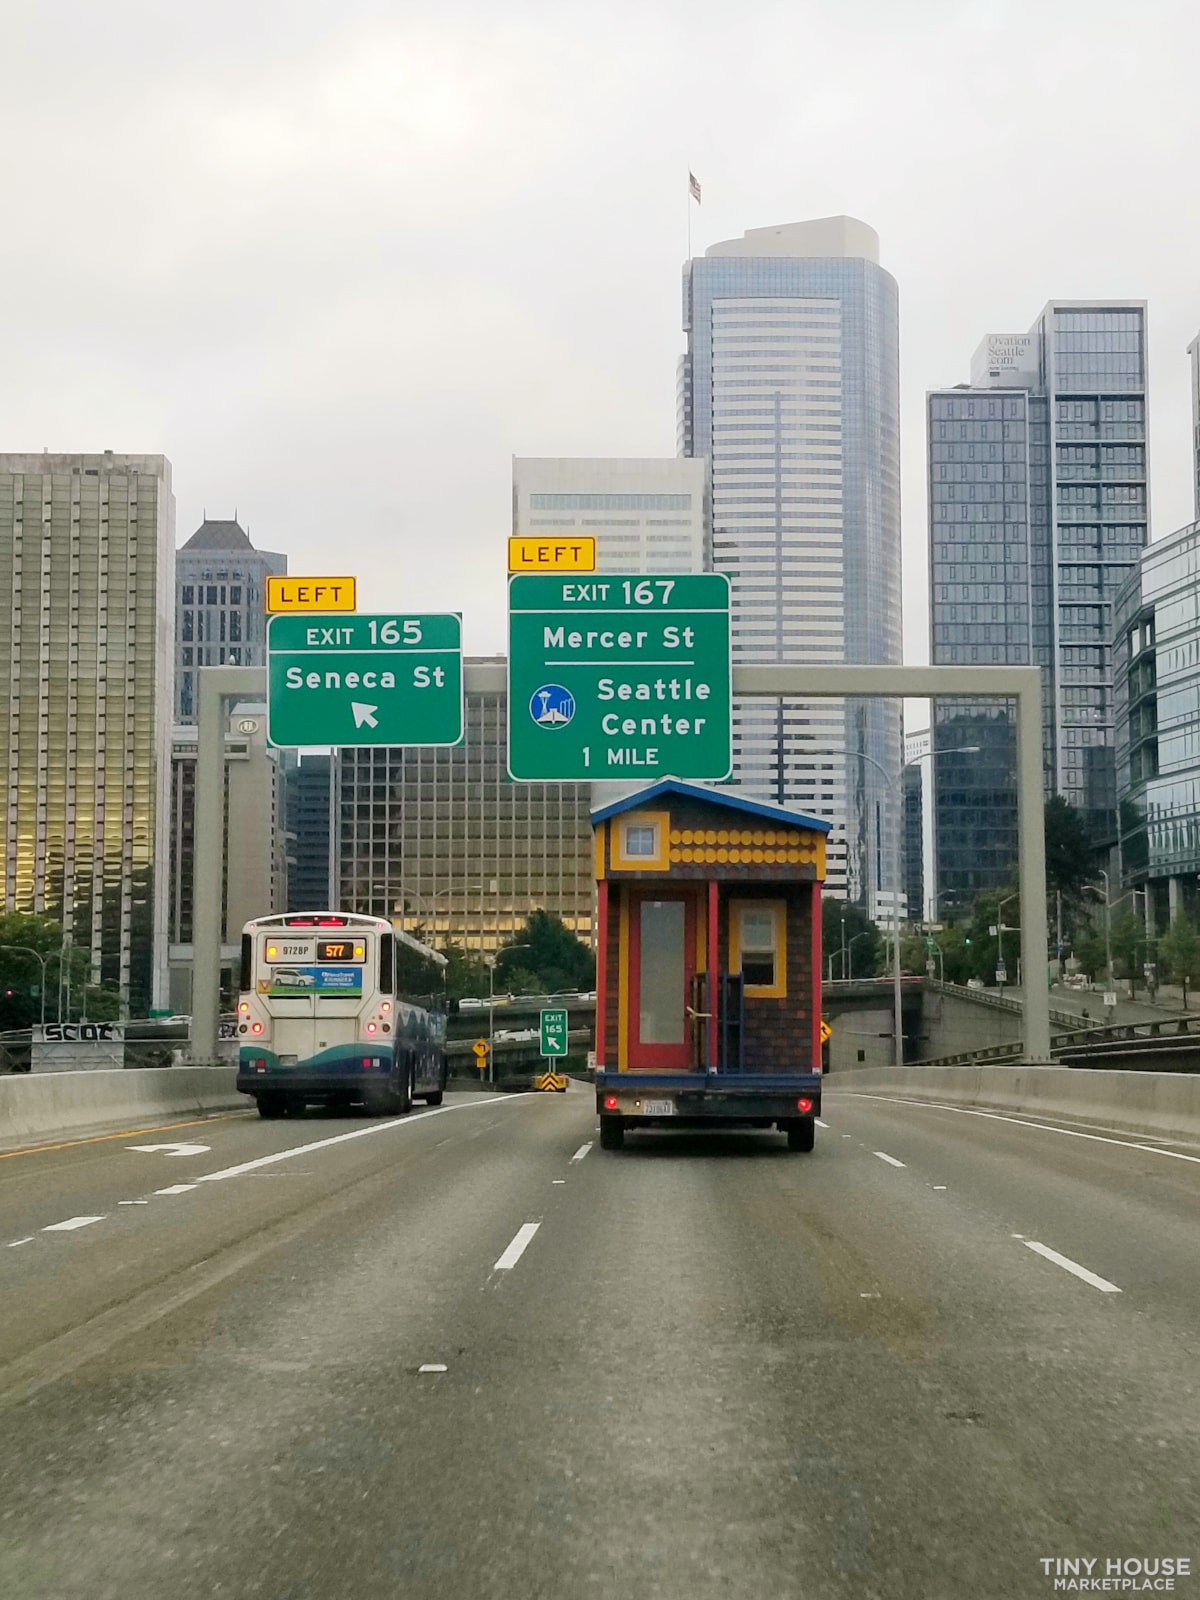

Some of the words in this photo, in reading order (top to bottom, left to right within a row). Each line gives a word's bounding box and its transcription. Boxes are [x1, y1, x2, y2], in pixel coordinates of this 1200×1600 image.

[988, 346, 1025, 356] Seattle
[521, 546, 582, 562] LEFT
[281, 586, 342, 602] LEFT
[562, 584, 610, 601] EXIT
[622, 580, 676, 605] 167
[306, 628, 354, 645] EXIT
[368, 619, 423, 645] 165
[543, 626, 648, 648] Mercer
[662, 626, 695, 648] St
[285, 666, 396, 689] Seneca
[412, 665, 445, 688] St
[597, 678, 711, 701] Seattle
[601, 713, 706, 735] Center
[582, 746, 590, 767] 1
[607, 748, 659, 765] MILE
[282, 946, 309, 955] 9728P
[325, 945, 345, 957] 577
[544, 1014, 563, 1022] EXIT
[545, 1025, 563, 1033] 165
